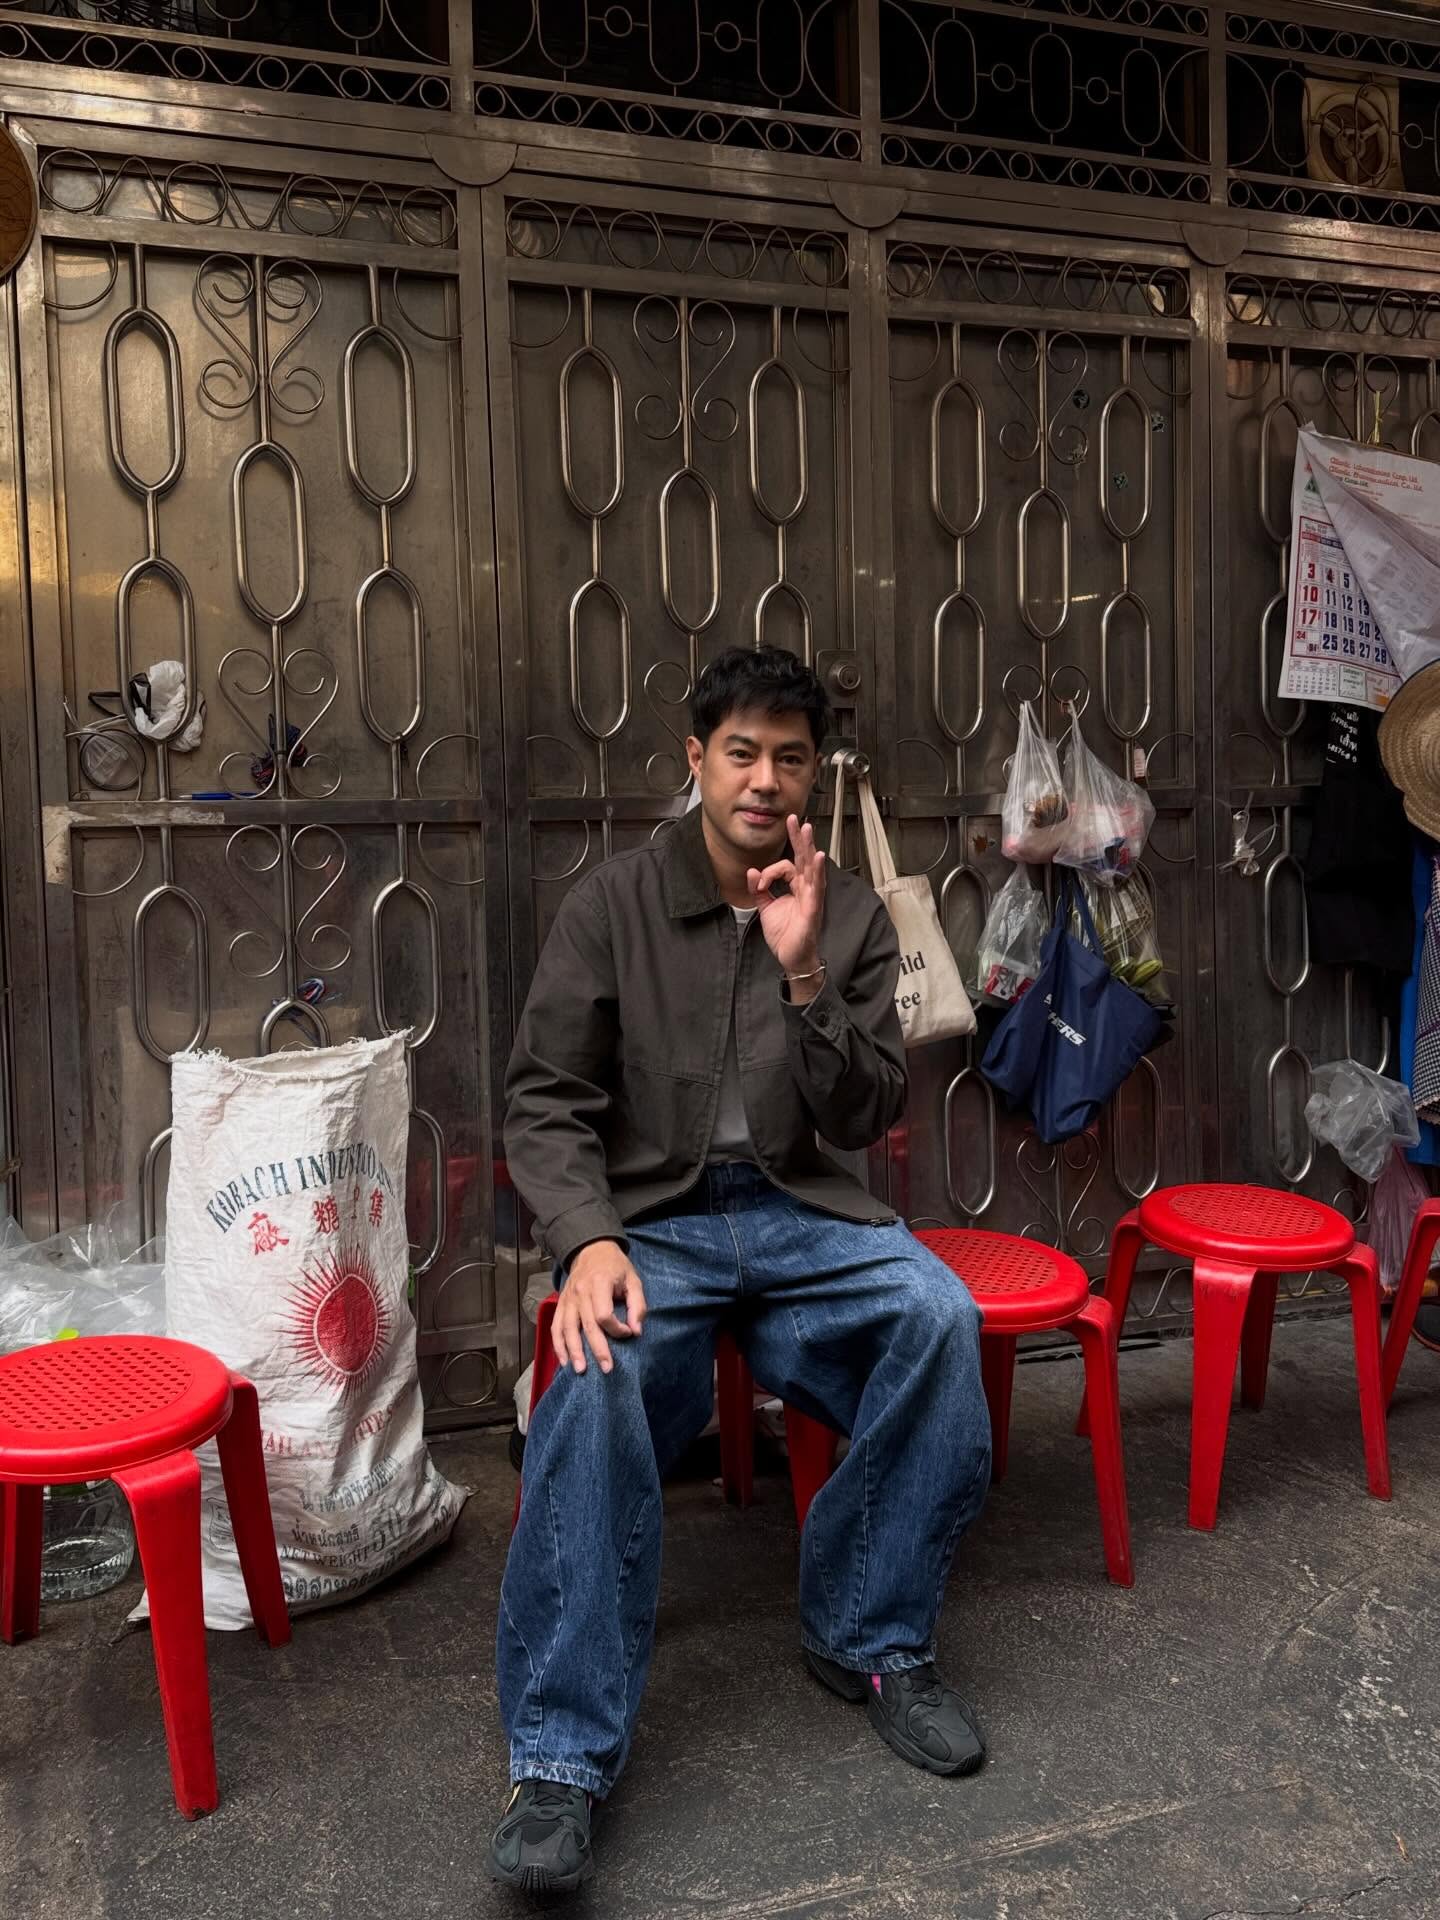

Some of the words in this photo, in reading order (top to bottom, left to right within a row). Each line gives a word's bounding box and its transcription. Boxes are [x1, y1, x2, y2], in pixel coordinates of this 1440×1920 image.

[1307, 563, 1315, 579] 3
[1343, 573, 1350, 588] 5
[1303, 585, 1319, 602] 10
[1325, 589, 1337, 606] 11
[1341, 594, 1353, 611] 12
[1358, 599, 1370, 616] 13
[1301, 608, 1318, 625] 17
[1324, 611, 1337, 628] 18
[1343, 615, 1354, 633] 19
[1358, 620, 1370, 638] 20
[1322, 634, 1338, 651] 25
[1342, 637, 1355, 655] 26
[1359, 642, 1371, 659] 27
[1374, 647, 1387, 665] 28
[900, 951, 926, 976] ild
[206, 1161, 292, 1234] KORACH
[280, 1544, 312, 1562] NET
[313, 1544, 370, 1568] WEIGHT
